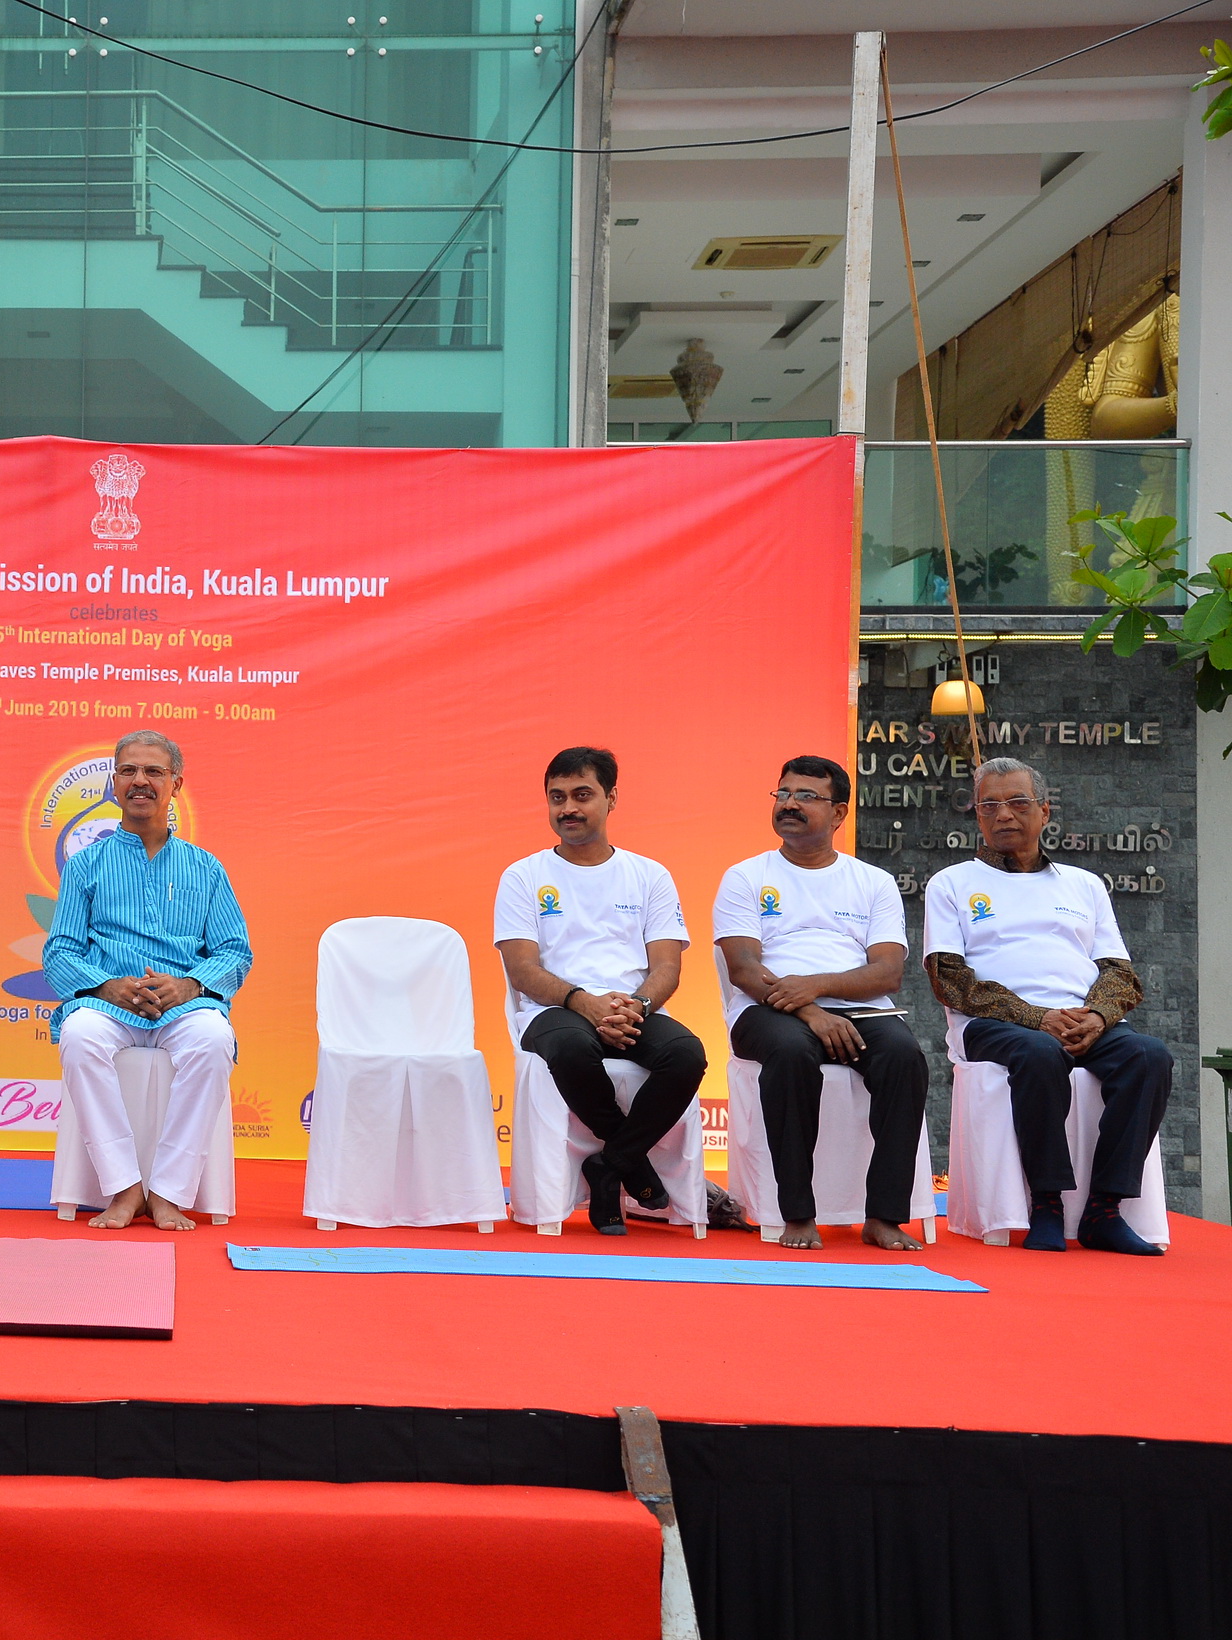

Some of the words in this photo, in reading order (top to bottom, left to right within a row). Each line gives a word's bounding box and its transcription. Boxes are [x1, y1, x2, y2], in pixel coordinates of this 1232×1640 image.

[85, 565, 115, 593] of
[121, 566, 194, 599] India,
[202, 567, 278, 597] Kuala
[286, 570, 390, 603] Lumpur
[69, 603, 158, 621] celebrates
[18, 626, 126, 646] International
[131, 629, 164, 650] Day
[168, 628, 186, 646] of
[190, 629, 233, 651] Yoga
[40, 662, 99, 684] Temple
[103, 663, 183, 685] Premises,
[187, 665, 233, 683] Kuala
[237, 666, 300, 687] Lumpur
[4, 699, 44, 716] June
[48, 700, 90, 717] 2019
[93, 701, 132, 719] from
[137, 702, 197, 719] 7.00am
[214, 703, 276, 721] 9.00am
[1038, 721, 1161, 745] TEMPLE
[40, 758, 112, 828] International
[80, 788, 101, 799] 21st
